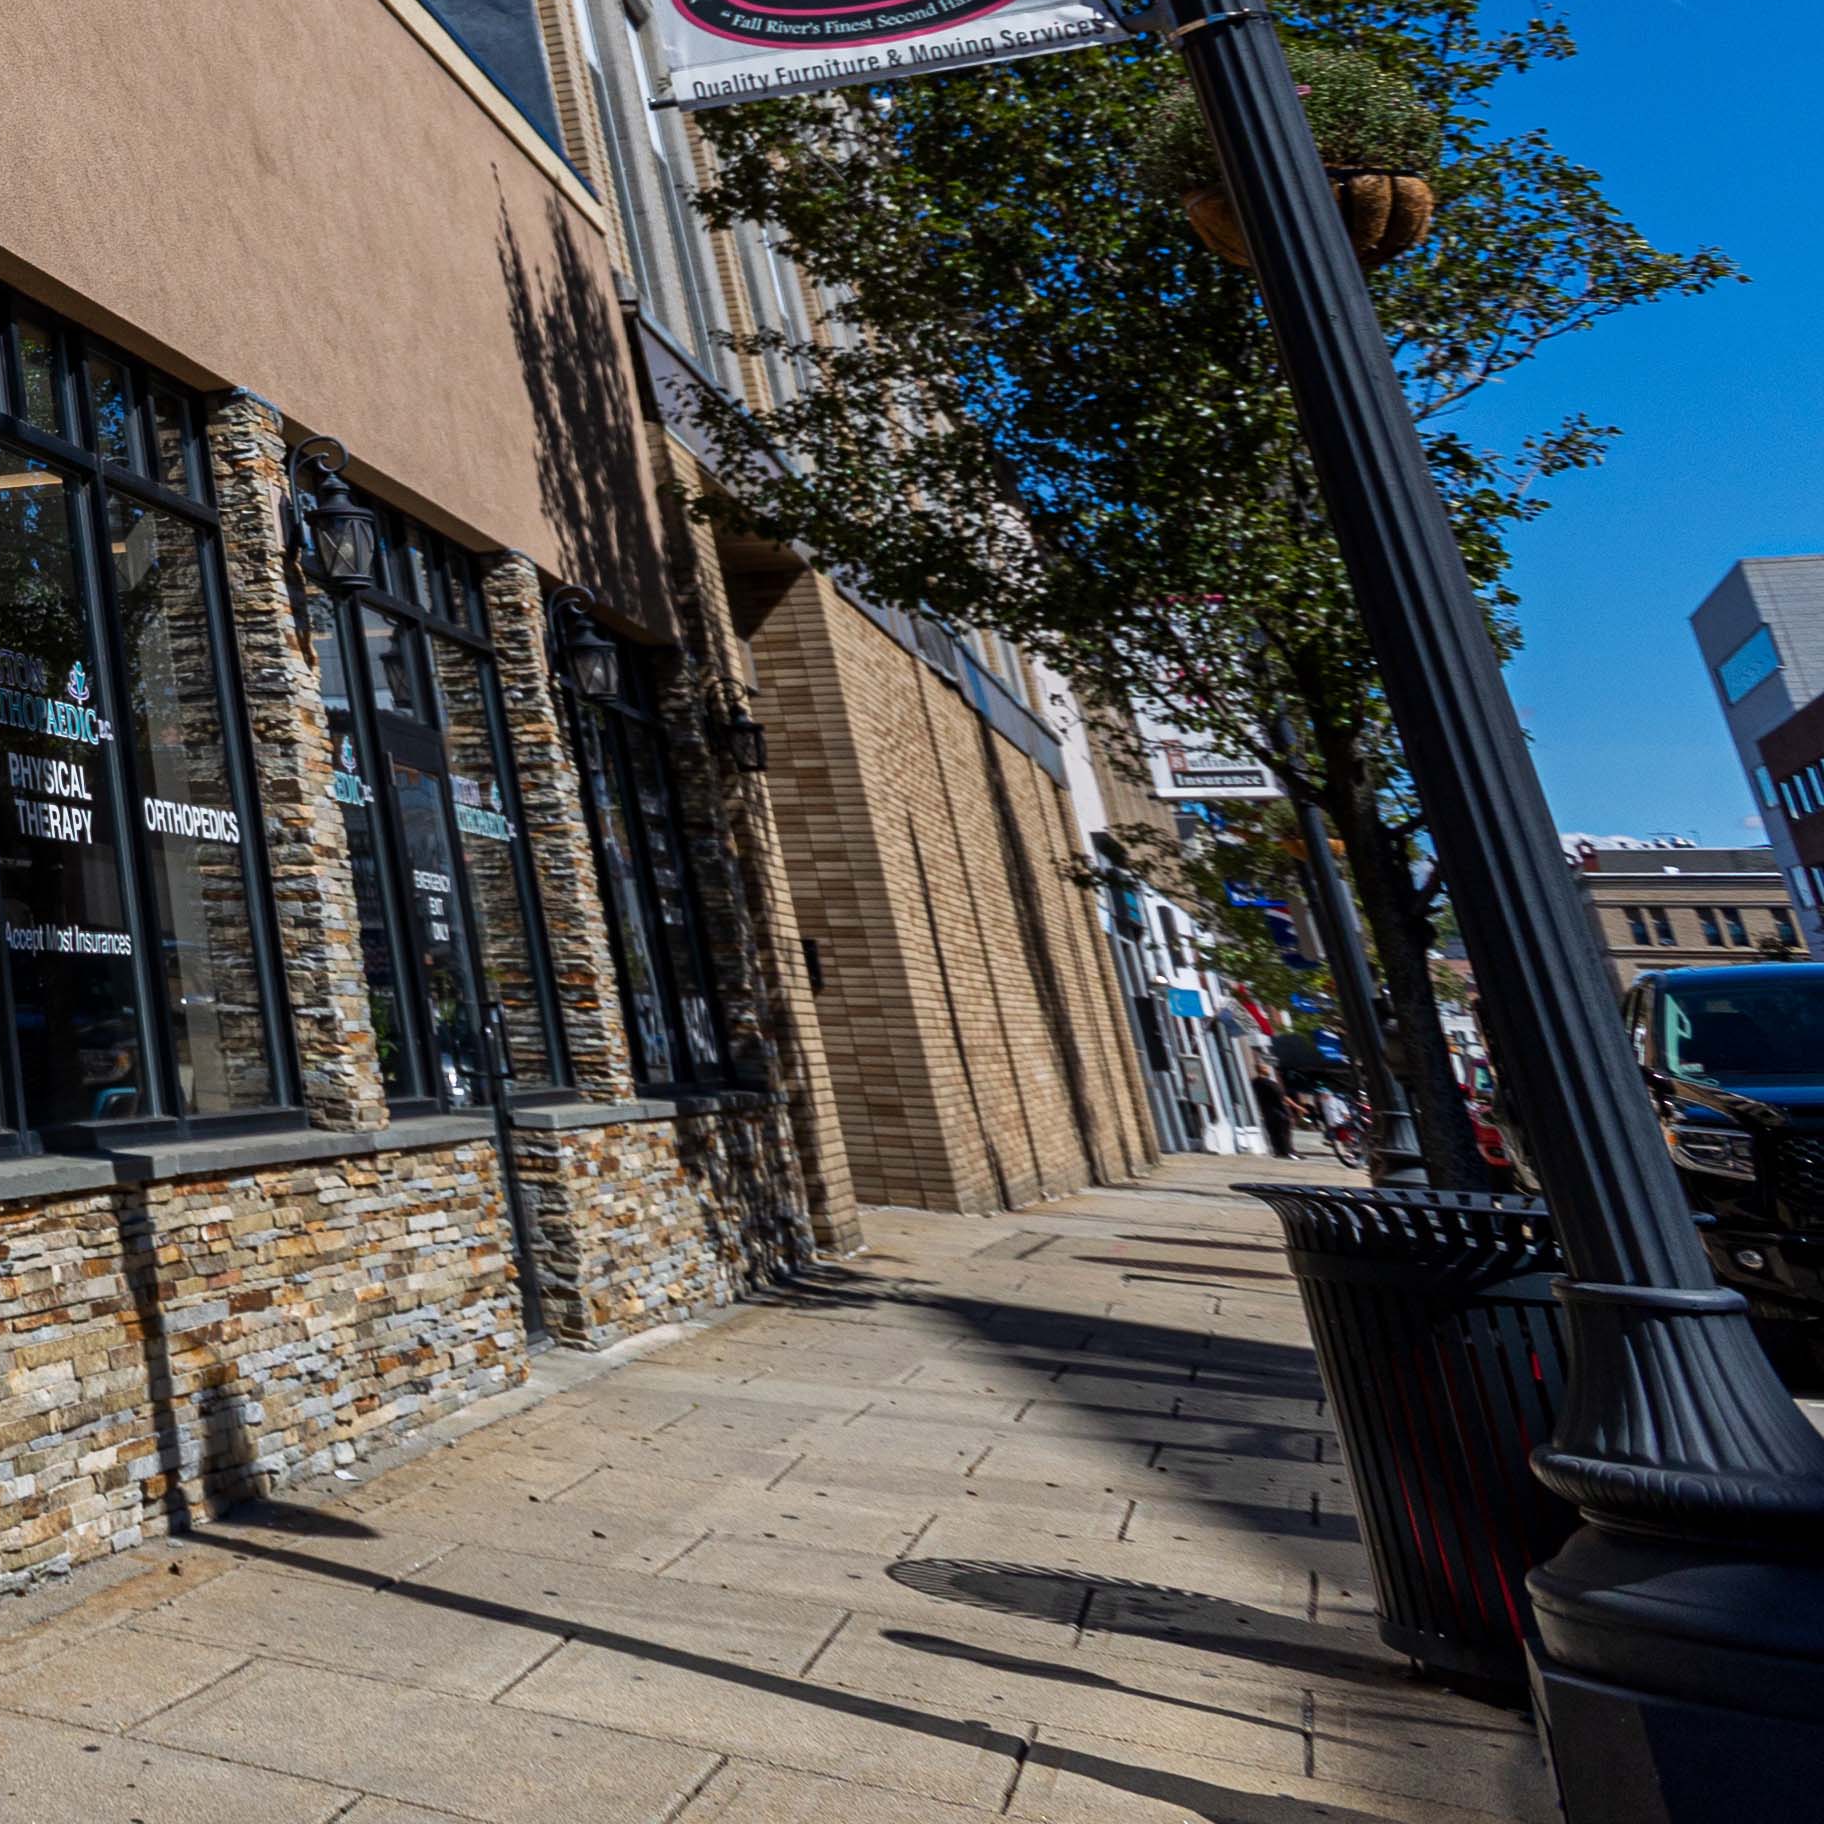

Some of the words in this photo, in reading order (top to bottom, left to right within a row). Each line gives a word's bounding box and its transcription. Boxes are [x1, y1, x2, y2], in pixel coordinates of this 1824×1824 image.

[765, 19, 821, 35] River's
[824, 18, 874, 35] Finest
[877, 2, 937, 28] Second
[692, 72, 769, 101] Quality
[774, 55, 881, 87] Furniture
[886, 49, 902, 68] &
[909, 37, 996, 57] Moving
[1000, 17, 1105, 49] Services
[8, 751, 92, 801] PHYSICAL
[14, 798, 93, 844] THERAPY
[143, 796, 241, 844] ORTHOPEDICS
[5, 921, 44, 957] Accept
[46, 923, 73, 953] Most
[75, 924, 131, 956] Insurances
